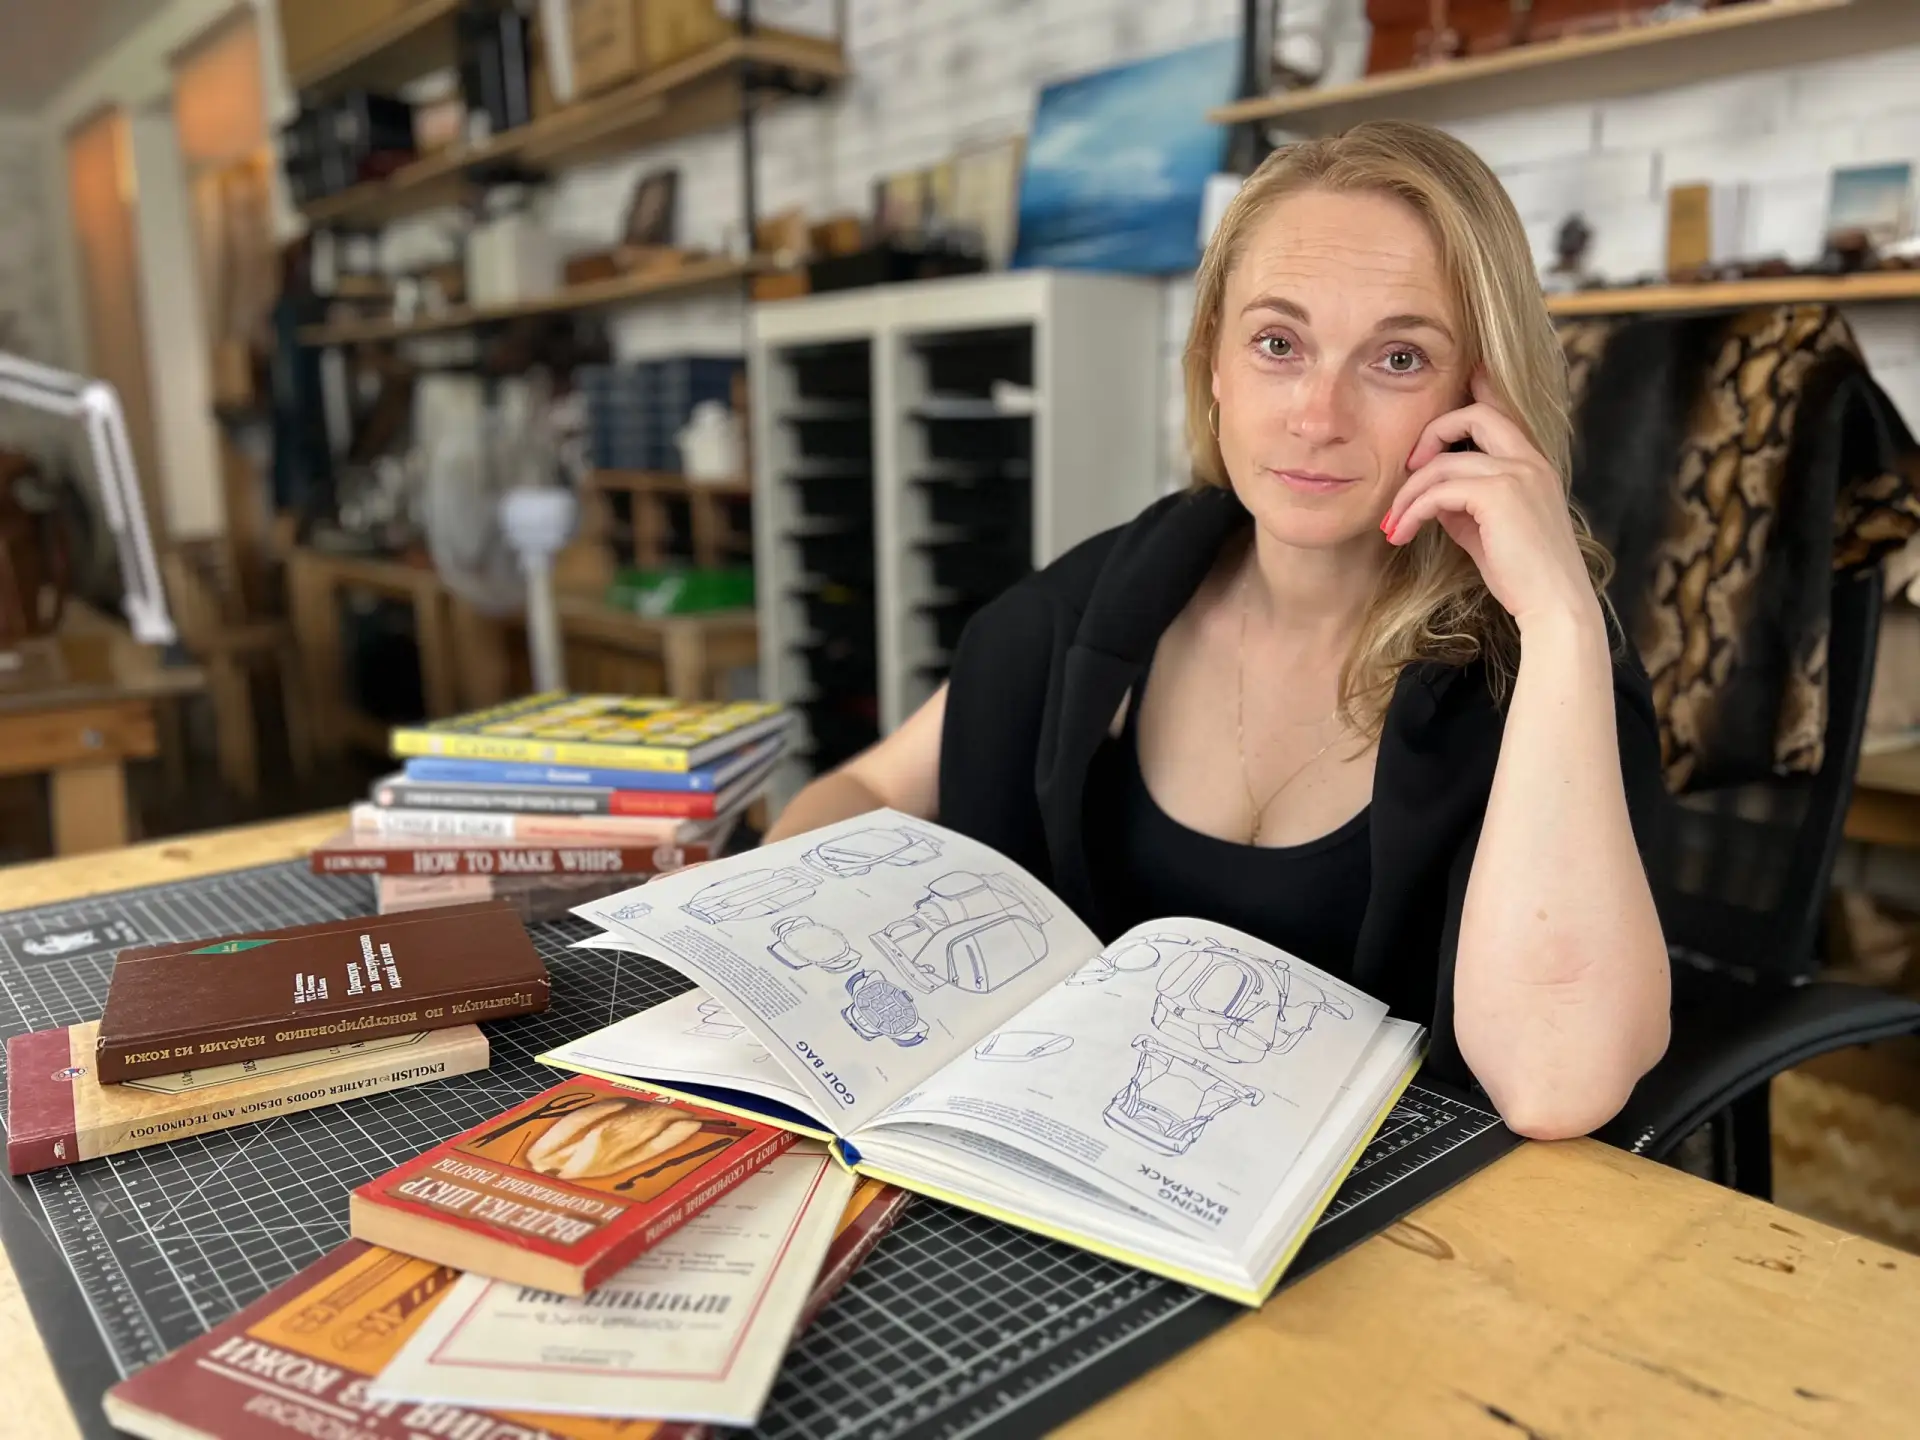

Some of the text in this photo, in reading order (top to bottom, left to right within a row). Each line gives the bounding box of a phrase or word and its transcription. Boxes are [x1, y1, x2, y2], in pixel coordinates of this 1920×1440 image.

[413, 849, 623, 872] HOW TO MAKE WHIPS
[425, 1007, 444, 1018] по
[451, 993, 533, 1014] Практикум
[275, 1011, 417, 1043] конструированию
[124, 1049, 170, 1065] кожи
[174, 1046, 193, 1057] из
[796, 1041, 855, 1105] GOLF BAG
[129, 1062, 445, 1140] ENGLISH LEATHER GOODS DESIGN AND TECHNOLOGY
[432, 1158, 625, 1221] И СКОРНЯЖНЫЕ РАБОТЫ
[1137, 1163, 1229, 1215] BACKPACK
[1157, 1188, 1222, 1226] HIKING
[398, 1176, 597, 1244] ВЫДЕЛКА ШКУР
[209, 1336, 344, 1395] КОЖИ
